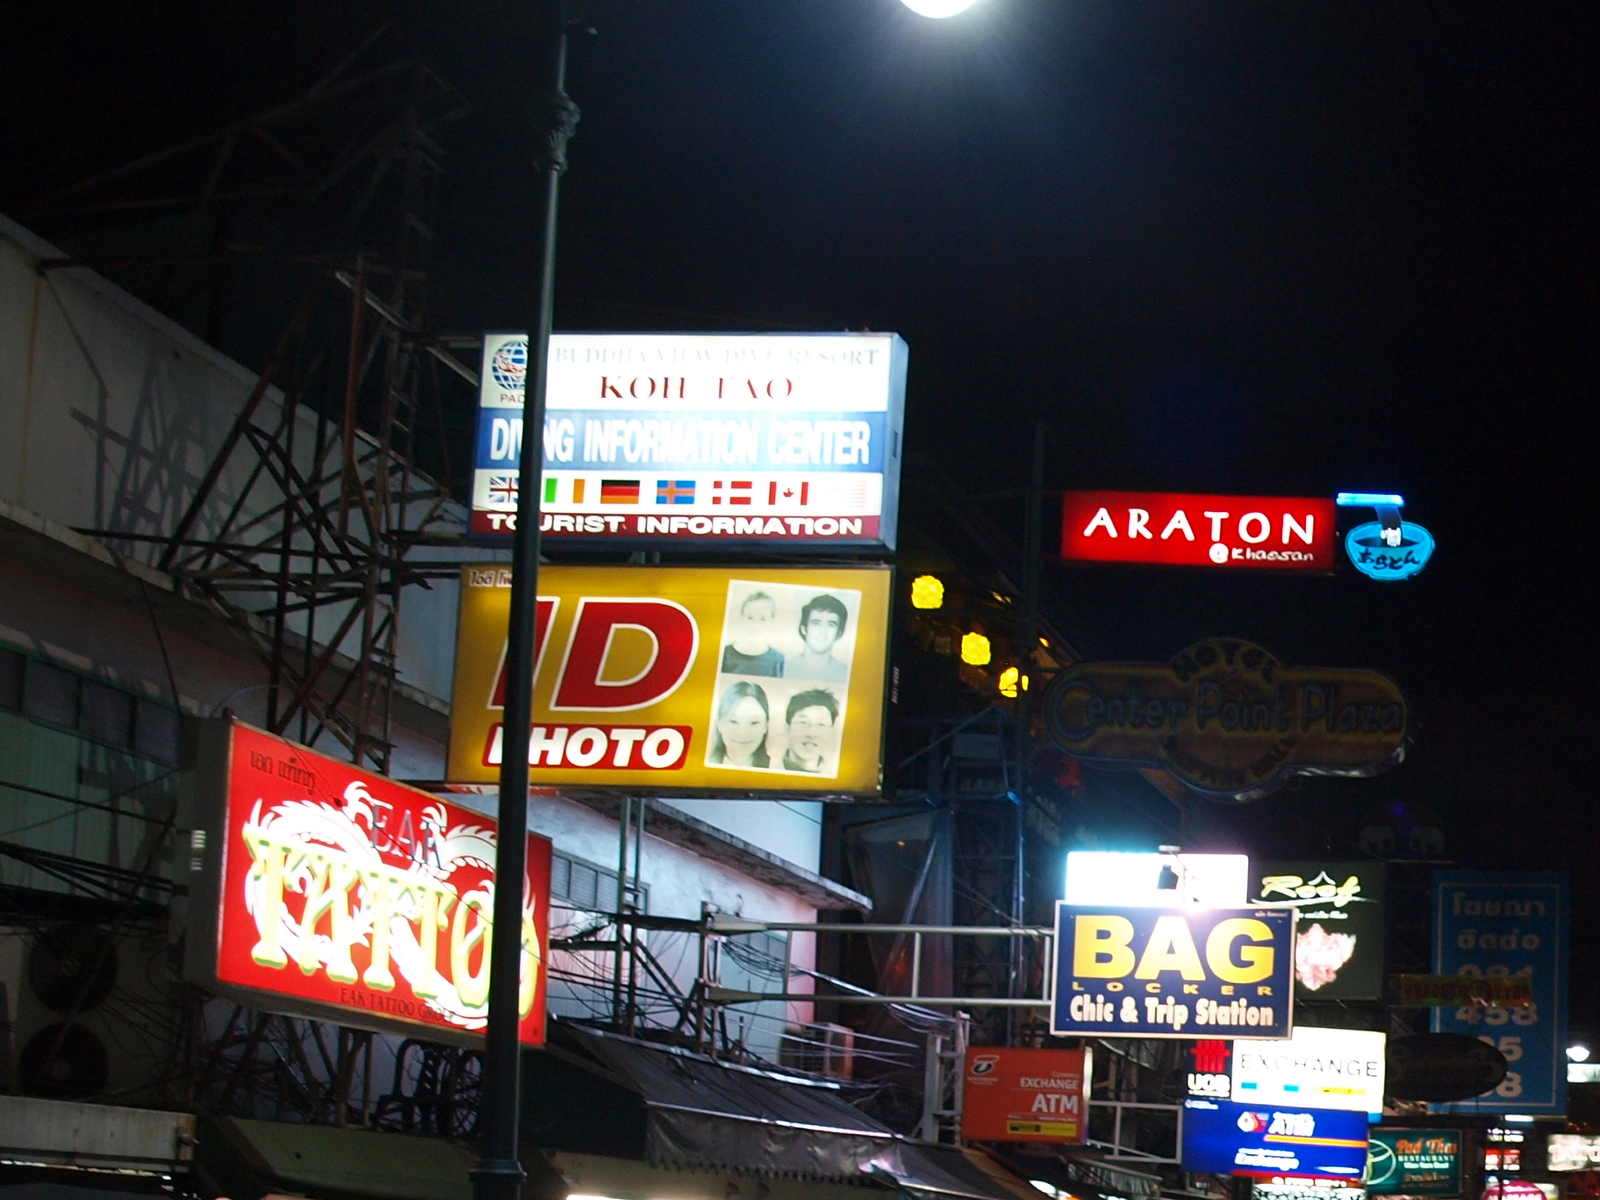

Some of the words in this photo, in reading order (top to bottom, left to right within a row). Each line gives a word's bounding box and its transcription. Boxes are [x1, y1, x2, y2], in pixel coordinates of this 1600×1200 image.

[788, 348, 880, 365] RESORT
[599, 375, 686, 399] KOH
[709, 376, 793, 400] TAO
[584, 419, 760, 465] INFORMATION
[768, 420, 871, 466] CENTER
[638, 515, 862, 535] INFORMATION
[1083, 506, 1315, 546] ARATON
[1053, 681, 1189, 742] Center
[1195, 681, 1293, 733] Point
[1301, 682, 1402, 733] Plaza
[488, 726, 686, 769] HOTO
[1073, 914, 1275, 984] BAG
[1072, 981, 1274, 996] LOCKER
[1070, 995, 1115, 1023] Chic
[1120, 997, 1139, 1024] &
[1145, 997, 1188, 1031] Trip
[1195, 998, 1274, 1026] Station
[1240, 1053, 1379, 1078] EXCHANGE
[1020, 1077, 1079, 1090] EXCHANGE
[1187, 1073, 1231, 1092] UOB
[1031, 1092, 1079, 1114] ATM
[1396, 1137, 1424, 1155] Pad
